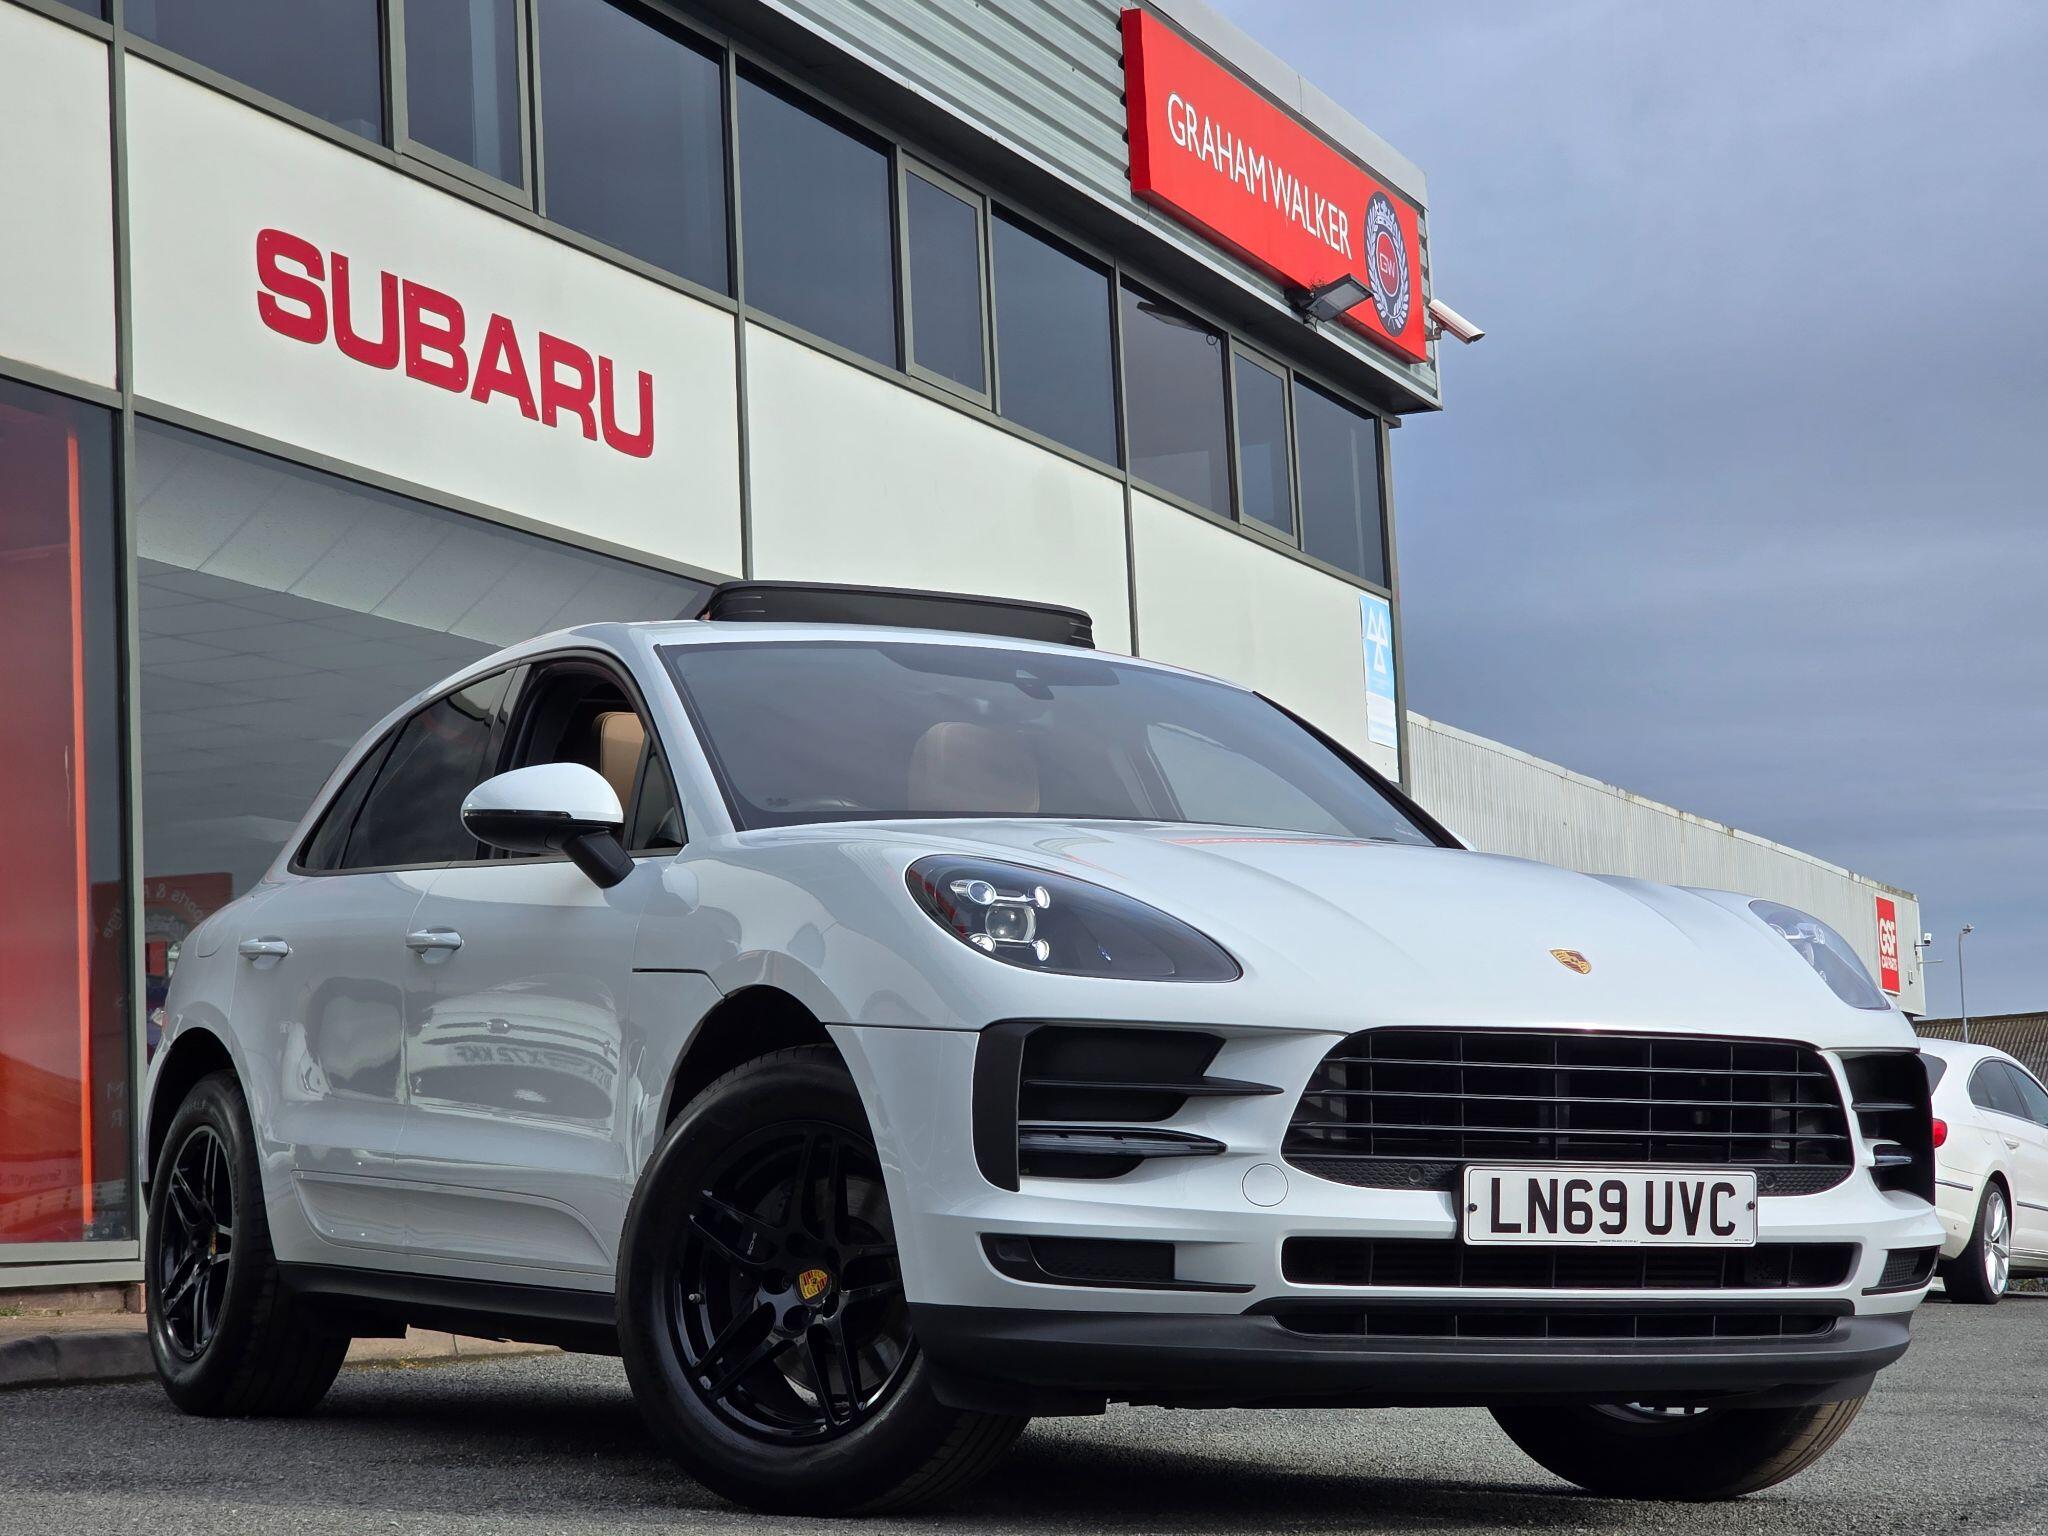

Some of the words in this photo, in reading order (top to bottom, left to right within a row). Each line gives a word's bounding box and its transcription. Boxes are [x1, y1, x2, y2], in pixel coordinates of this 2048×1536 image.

[1167, 93, 1267, 203] GRAHAM
[1268, 159, 1352, 261] WALKER
[256, 228, 655, 459] SUBARU
[1490, 1177, 1628, 1235] LN69
[1645, 1180, 1736, 1237] UVC
